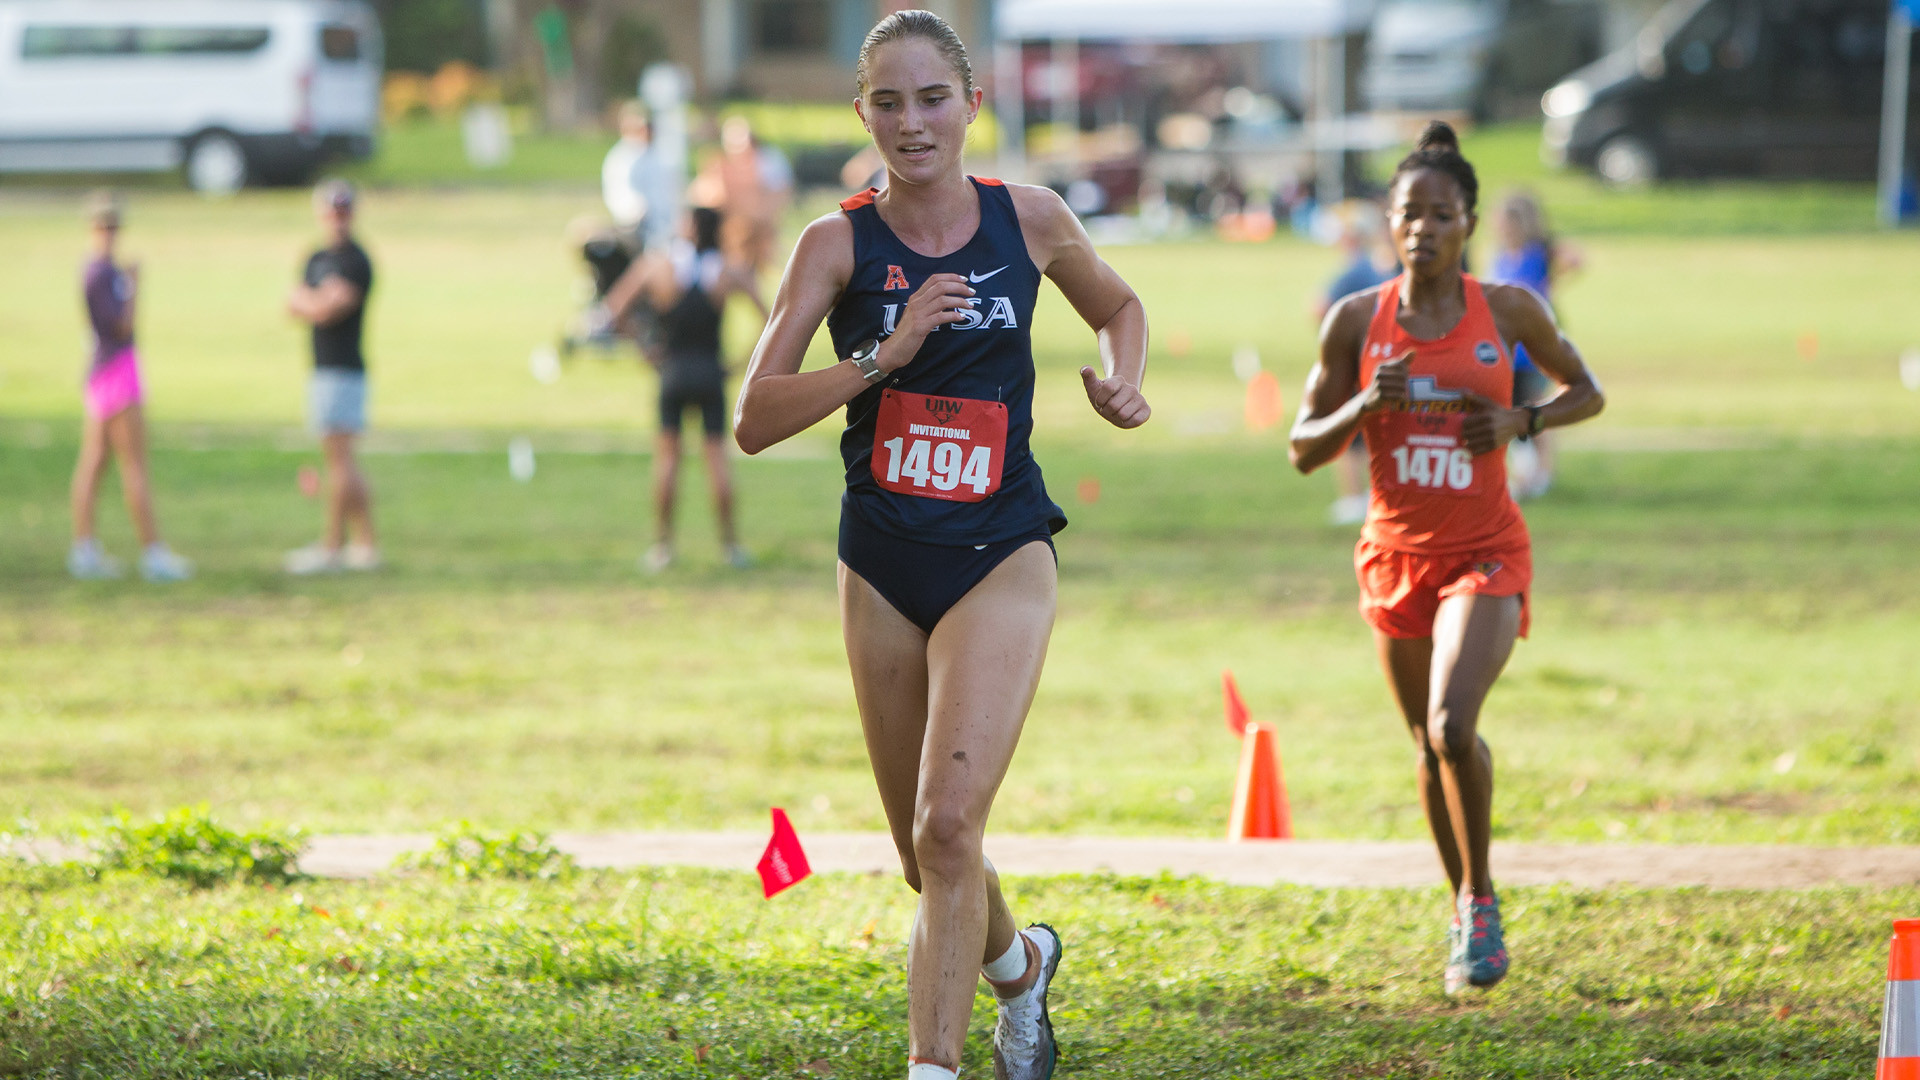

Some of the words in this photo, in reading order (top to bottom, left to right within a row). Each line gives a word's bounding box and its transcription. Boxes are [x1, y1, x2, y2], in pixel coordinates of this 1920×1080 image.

[884, 264, 909, 291] A
[883, 296, 1018, 336] USA
[925, 398, 963, 415] UIW
[909, 423, 971, 440] INVITATIONAL
[883, 436, 991, 495] 1494
[1391, 446, 1474, 490] 1476
